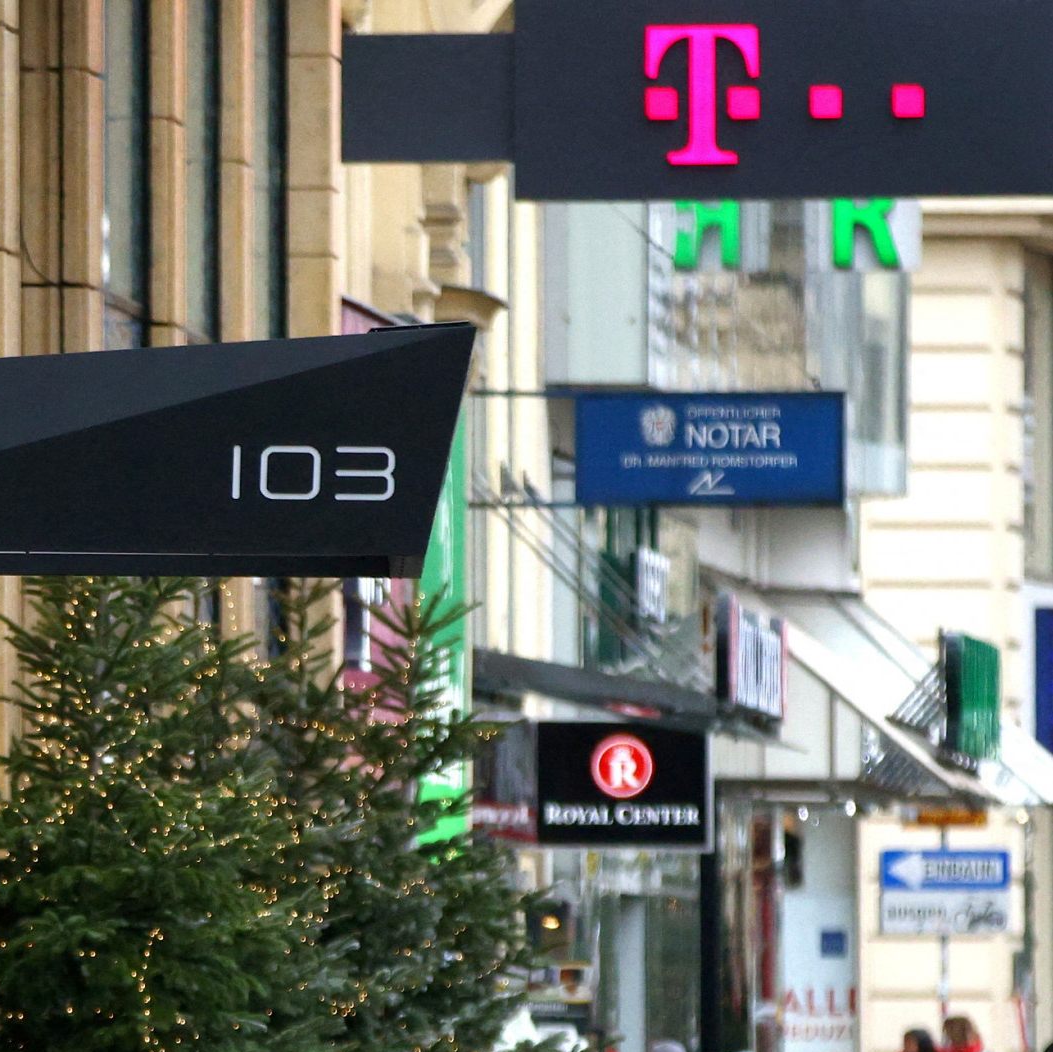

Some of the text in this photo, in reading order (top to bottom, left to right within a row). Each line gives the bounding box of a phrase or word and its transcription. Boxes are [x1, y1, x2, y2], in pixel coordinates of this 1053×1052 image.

[645, 24, 760, 165] T
[686, 422, 781, 448] NOTAR
[232, 445, 395, 500] 103
[544, 803, 612, 826] ROYAL
[616, 803, 700, 826] CENTER
